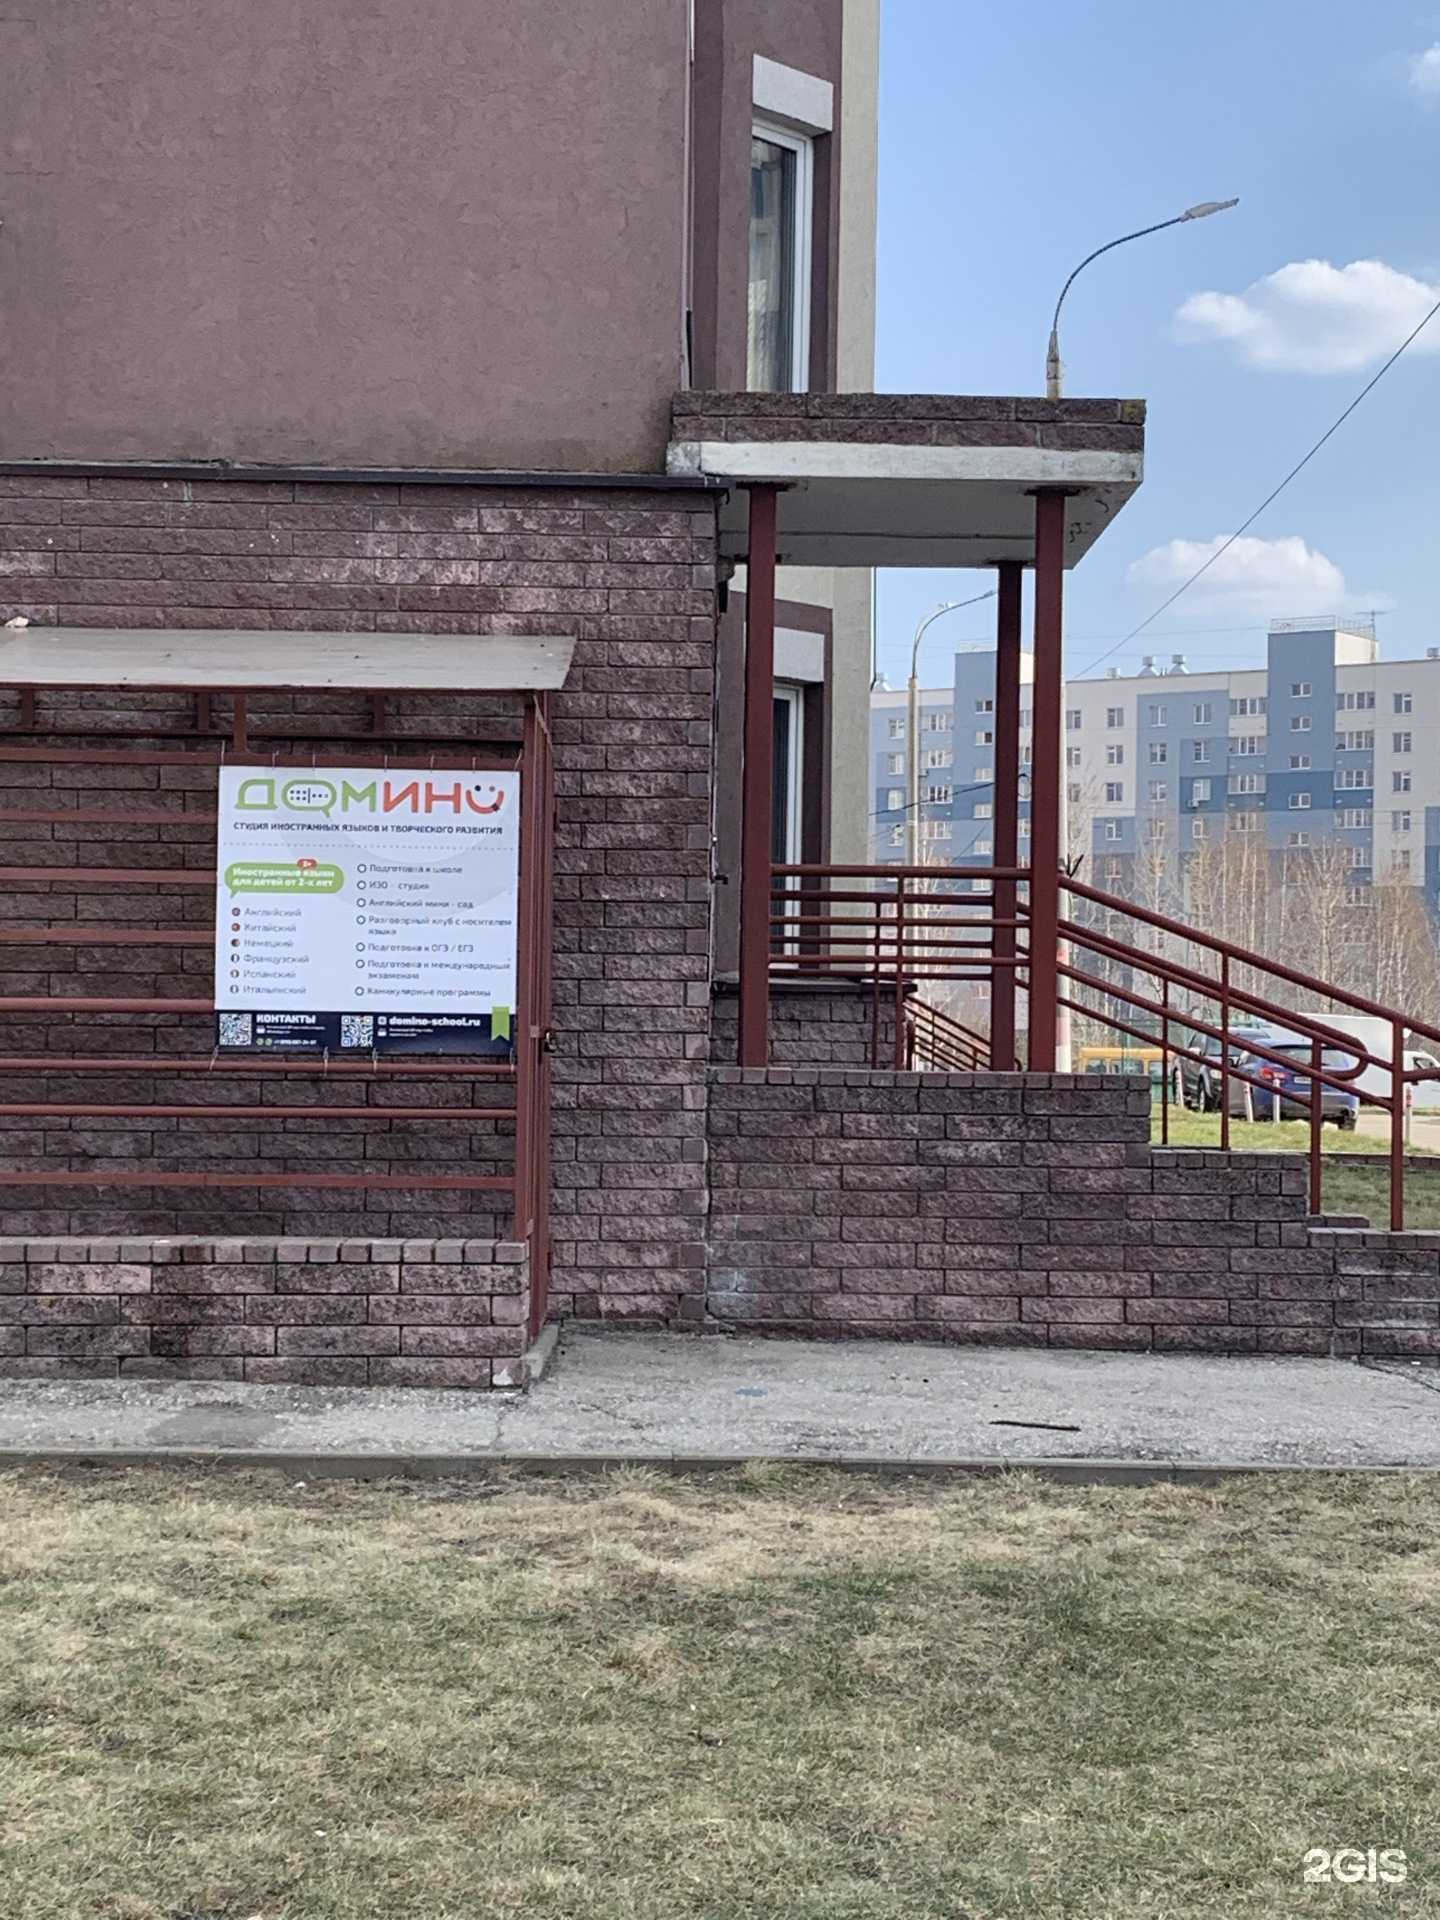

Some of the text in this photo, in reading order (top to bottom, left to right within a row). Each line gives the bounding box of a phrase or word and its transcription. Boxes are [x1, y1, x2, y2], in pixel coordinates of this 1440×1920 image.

[233, 822, 269, 831] СТУДИЯ
[271, 822, 340, 832] ИНОСТРАННЫХ
[342, 824, 380, 832] ЯЗЫКОВ
[391, 825, 454, 834] ТВОРЧЕСКОГО
[455, 826, 503, 835] РАЗВИТИЯ
[369, 864, 424, 873] Подготовка
[369, 881, 388, 889] ИЗО
[397, 883, 430, 891] студия
[368, 899, 423, 908] Английский
[243, 908, 302, 917] Английский
[368, 915, 430, 926] Разговорный
[431, 917, 454, 926] клуб
[243, 924, 297, 933] Китайский
[243, 940, 294, 948] Немецкий
[367, 943, 423, 953] Подготовка
[243, 954, 310, 965] Французский
[367, 960, 422, 970] Подготовка
[242, 970, 297, 979] Испанский
[242, 985, 307, 995] Итальянский
[436, 989, 492, 998] программы
[256, 1014, 316, 1024] КОНТАКТЫ
[389, 1016, 481, 1027] domino-school.ru
